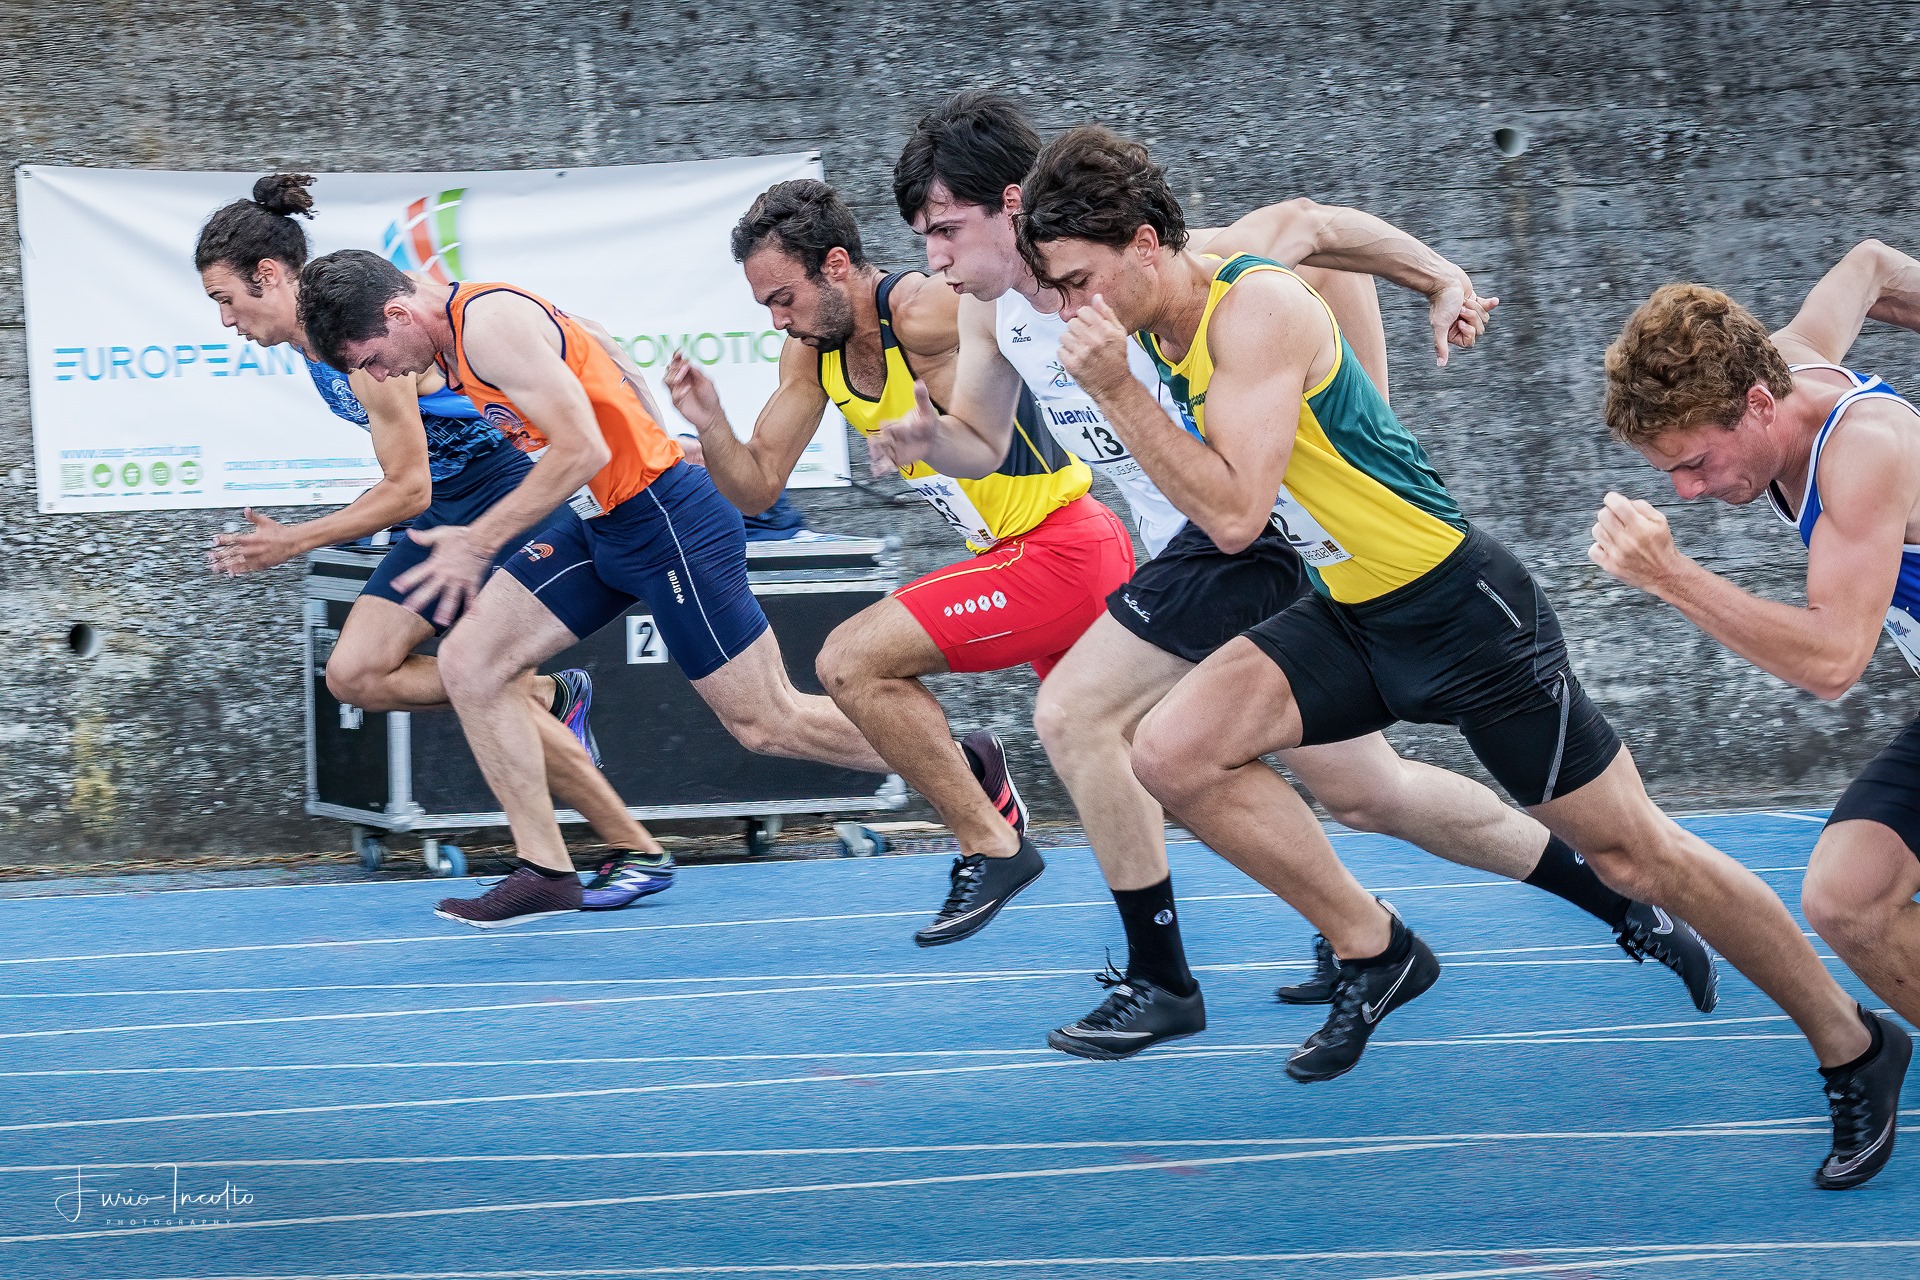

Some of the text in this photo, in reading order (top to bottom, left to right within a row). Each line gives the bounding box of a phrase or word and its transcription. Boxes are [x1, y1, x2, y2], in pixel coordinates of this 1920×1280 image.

[54, 344, 296, 381] EUROPEAN
[1081, 426, 1124, 458] 13
[637, 622, 657, 657] 2
